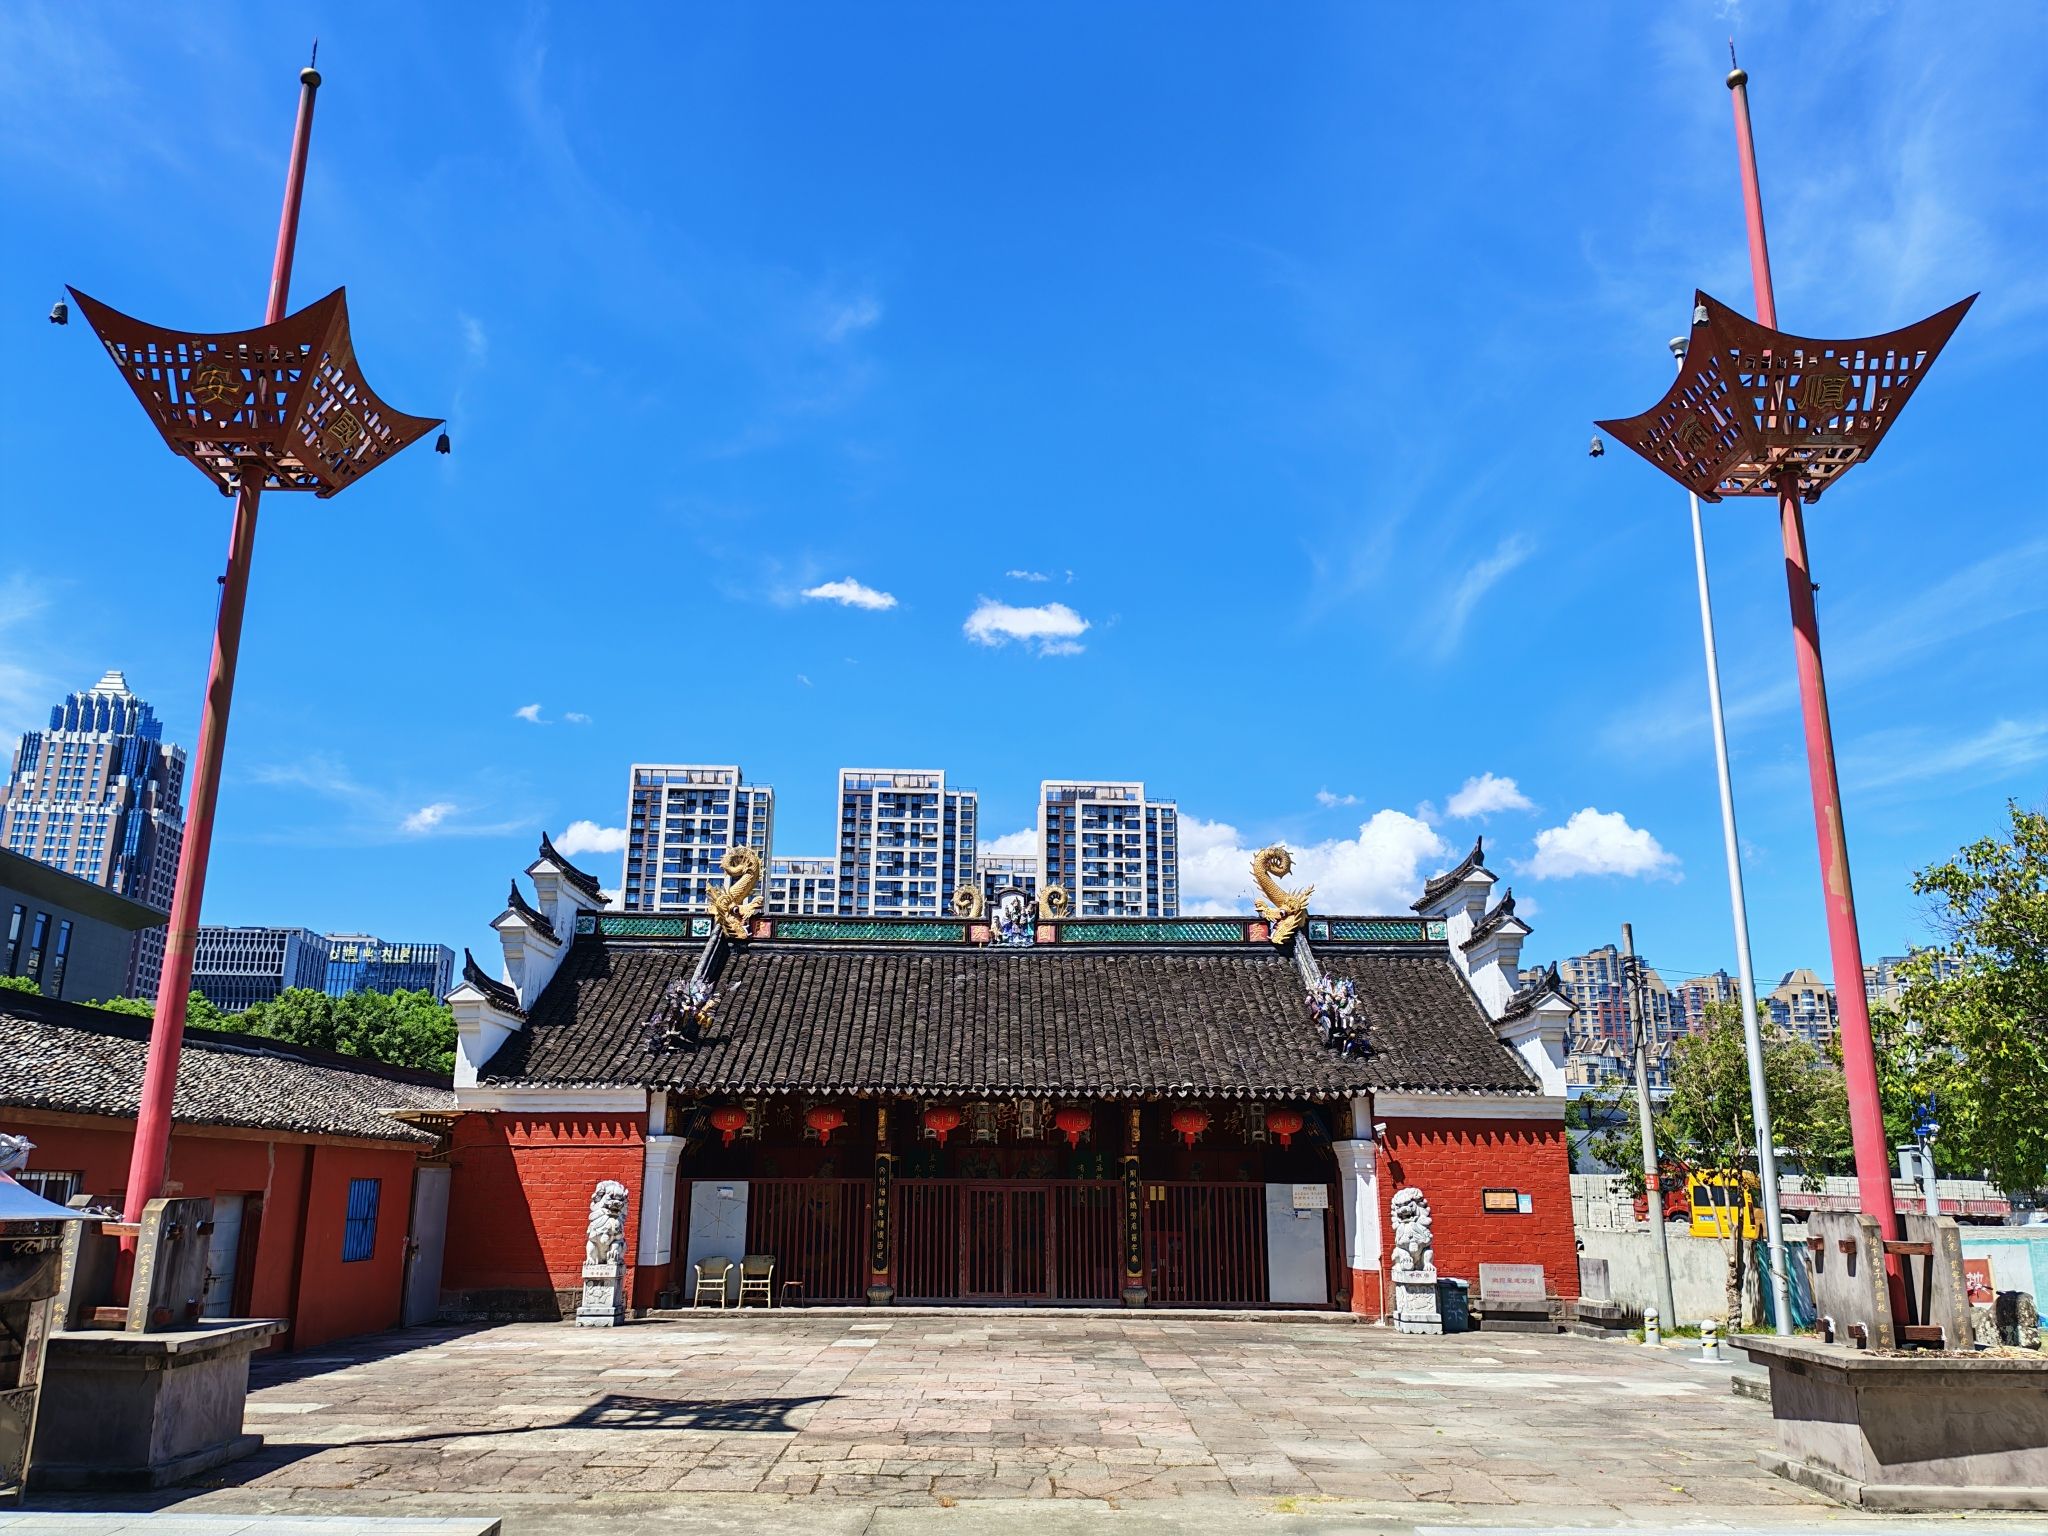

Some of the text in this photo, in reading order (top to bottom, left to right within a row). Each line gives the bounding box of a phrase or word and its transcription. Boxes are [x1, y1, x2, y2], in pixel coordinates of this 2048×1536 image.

[191, 362, 242, 407] 安
[1797, 373, 1851, 411] 順
[327, 406, 363, 448] 國
